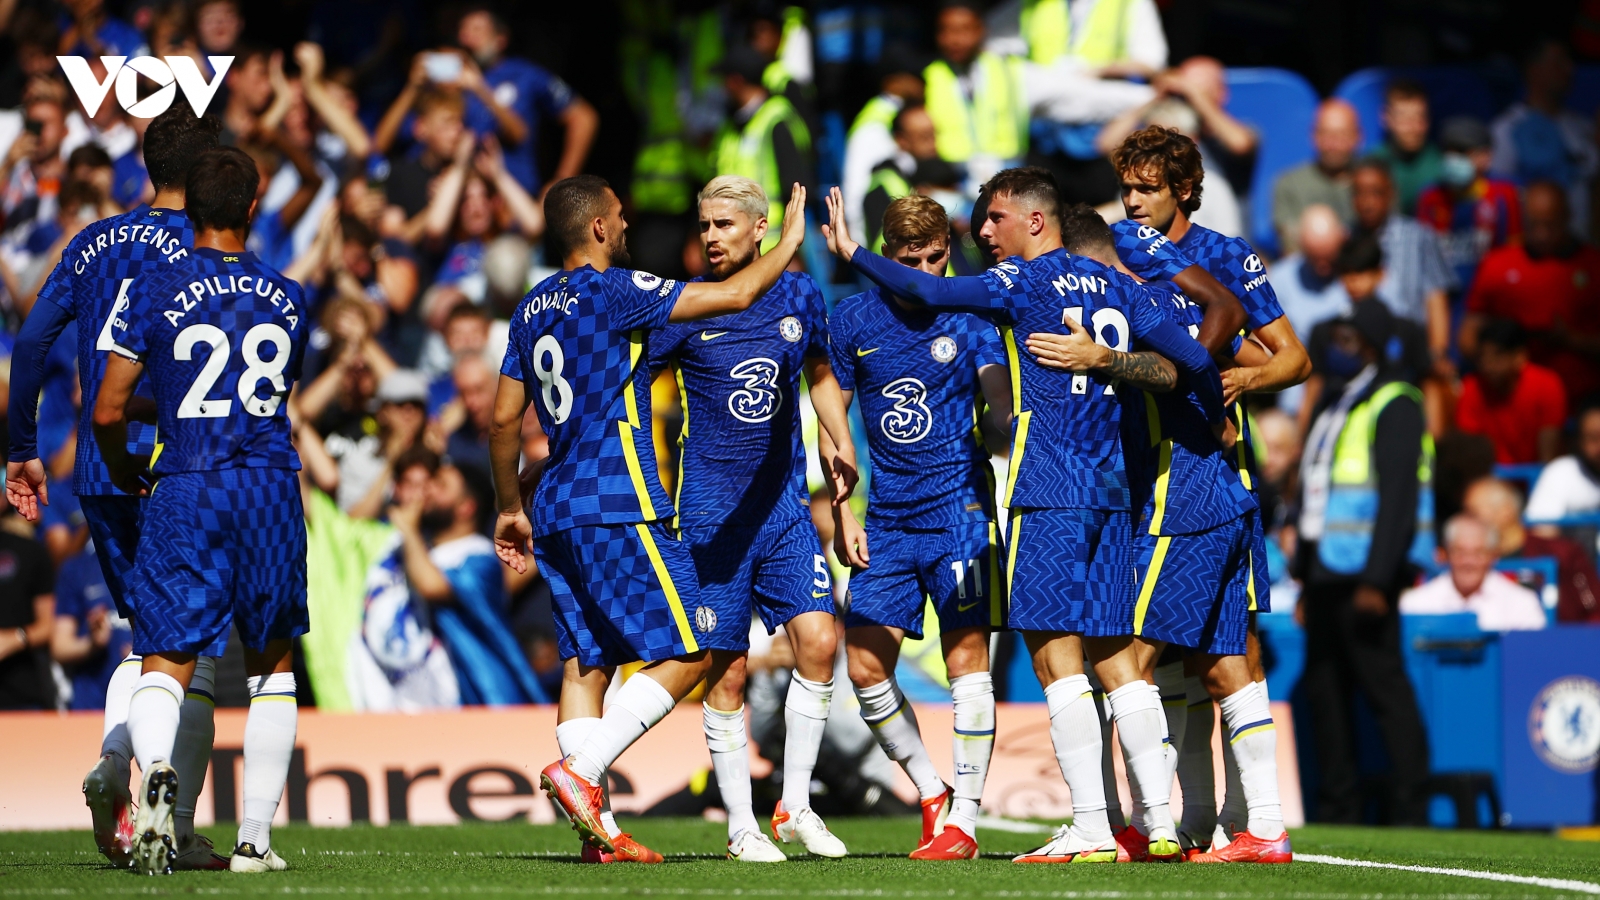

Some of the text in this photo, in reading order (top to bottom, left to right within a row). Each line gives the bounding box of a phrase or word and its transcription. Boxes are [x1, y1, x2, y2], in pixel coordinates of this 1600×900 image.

[163, 275, 299, 331] AZPILICUETA
[173, 322, 292, 419] 28
[533, 334, 574, 425] 8
[813, 553, 831, 589] 5
[951, 558, 983, 599] 11
[956, 762, 981, 772] CFC
